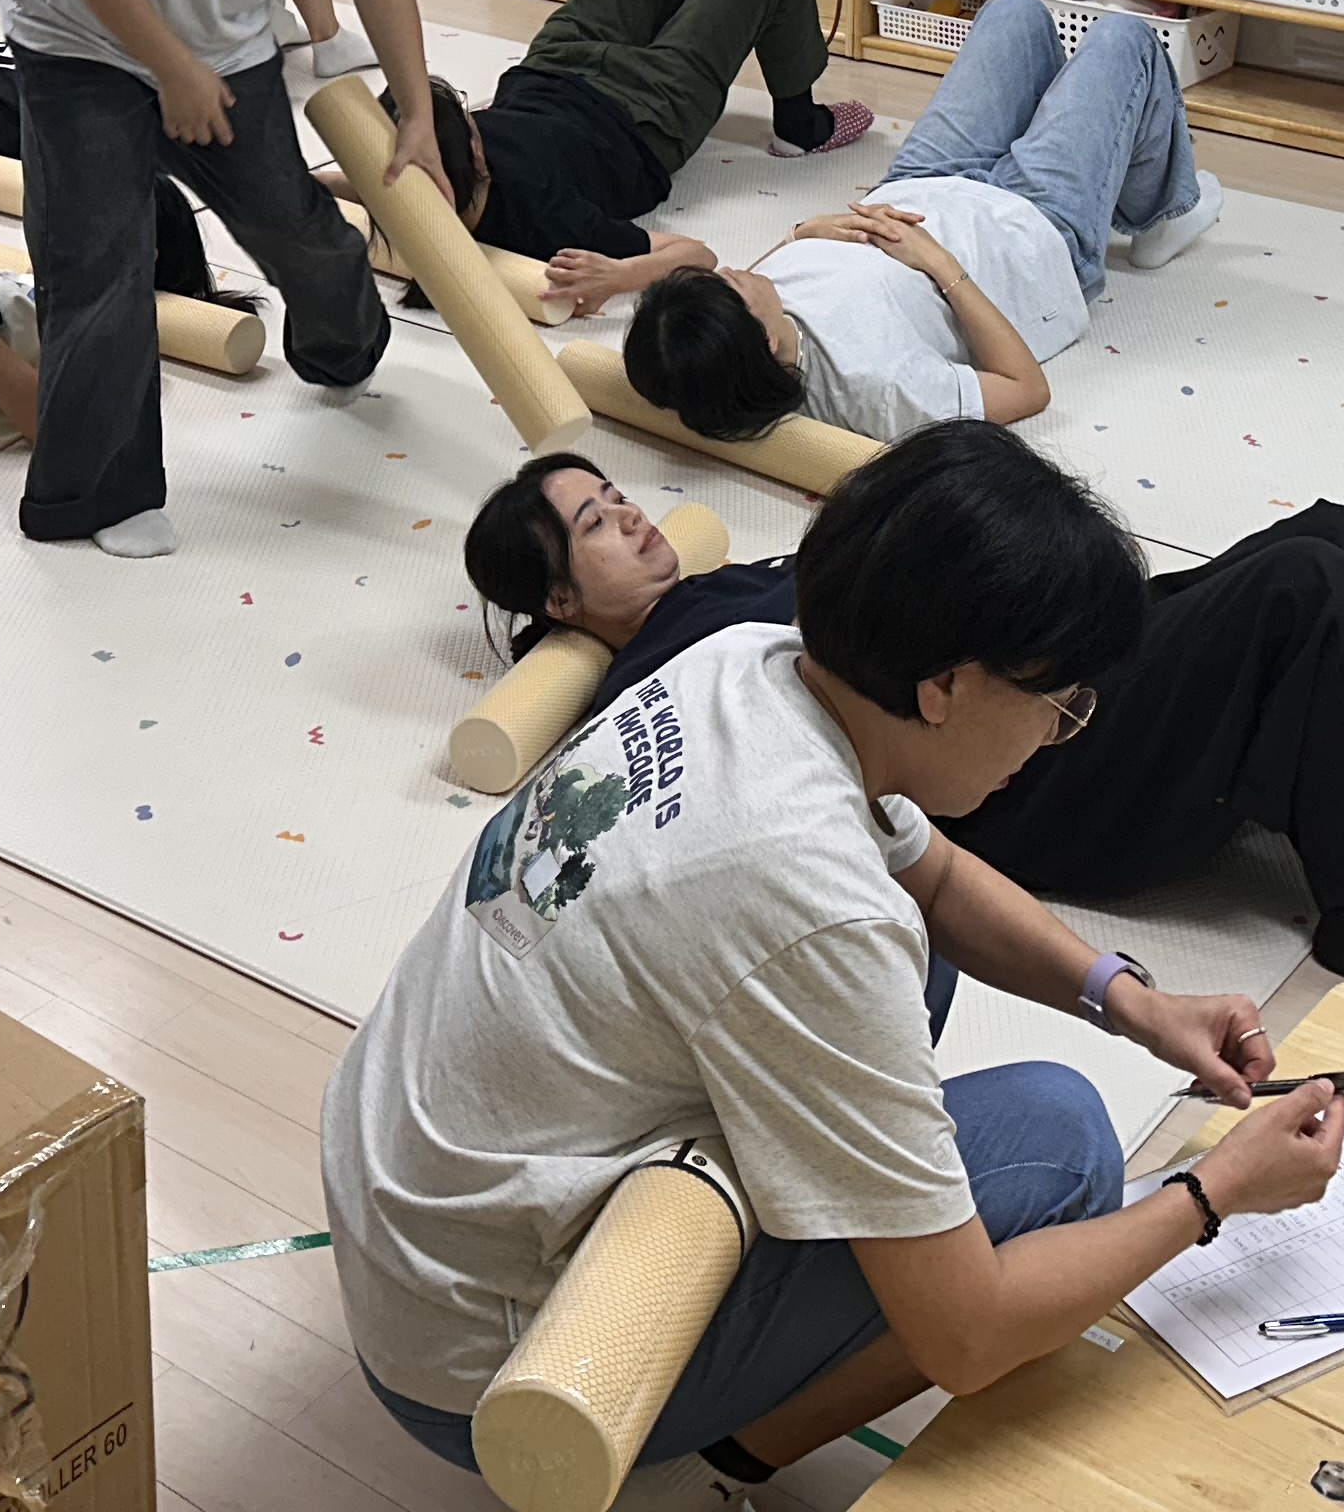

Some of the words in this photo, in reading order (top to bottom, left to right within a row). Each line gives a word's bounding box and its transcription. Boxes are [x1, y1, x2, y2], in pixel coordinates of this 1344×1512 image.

[635, 678, 669, 711] THE
[613, 707, 655, 816] AWESOME
[651, 705, 685, 790] WORLD
[655, 792, 683, 829] IS
[104, 1423, 128, 1457] 60
